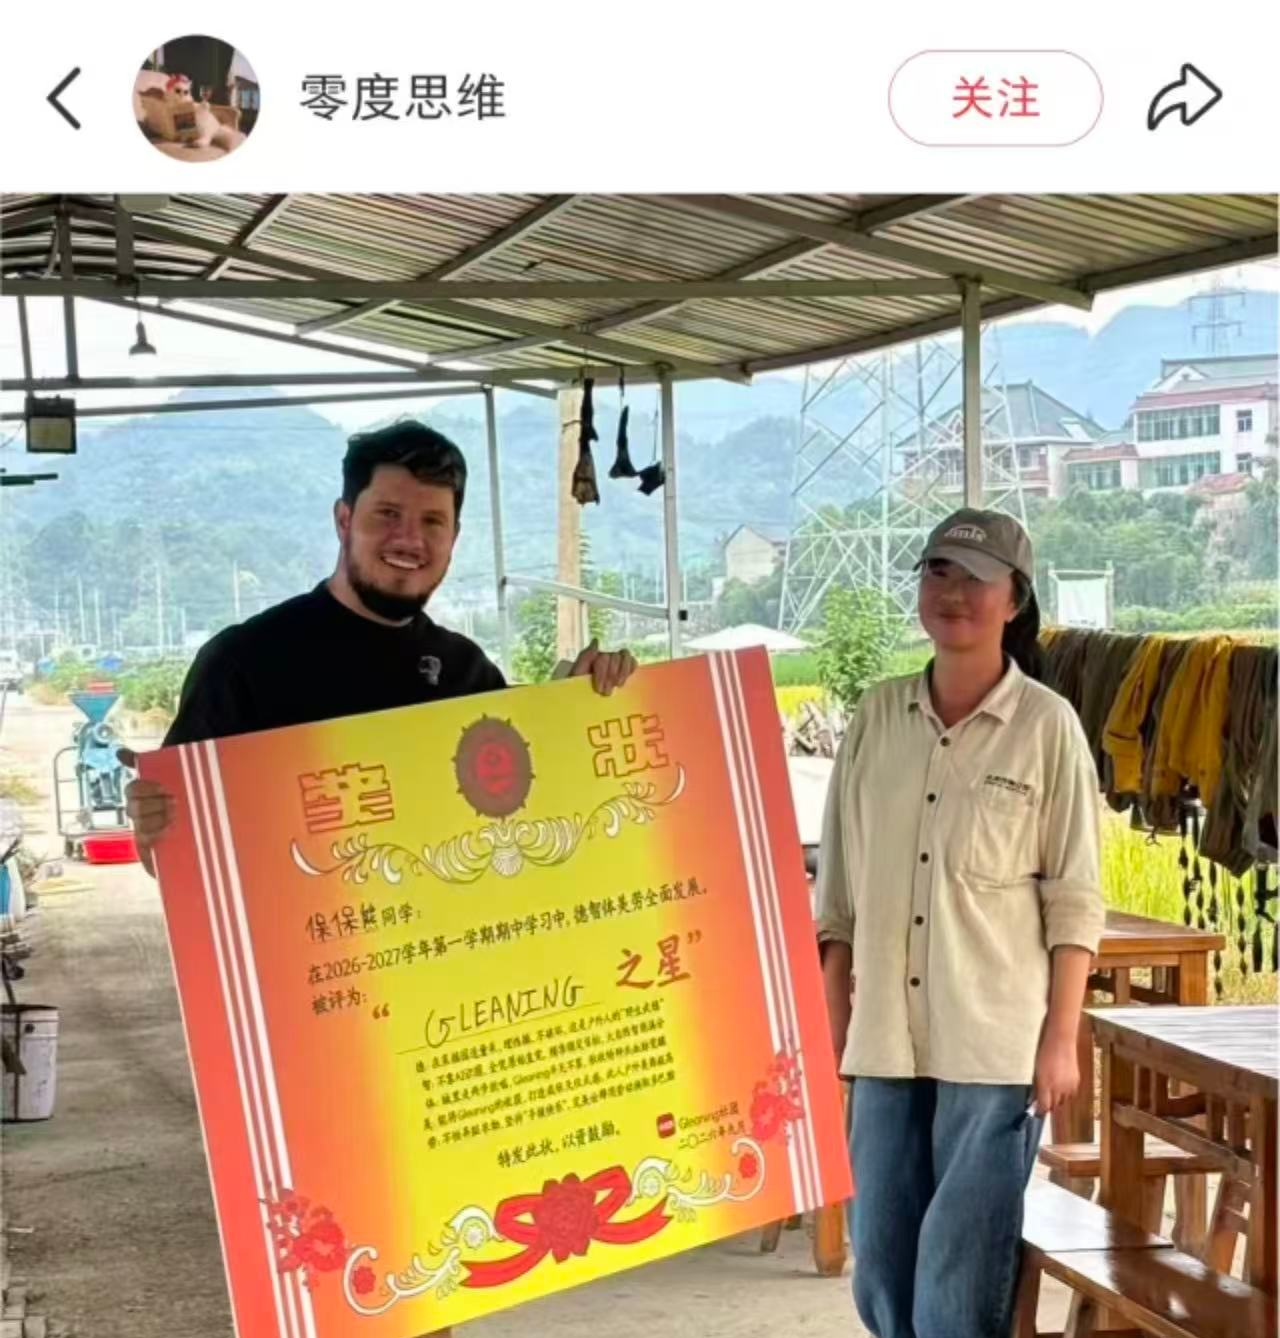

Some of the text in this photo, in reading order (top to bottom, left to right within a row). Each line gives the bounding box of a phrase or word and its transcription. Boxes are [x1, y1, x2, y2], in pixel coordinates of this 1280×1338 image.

[297, 713, 670, 834] 奖 状
[424, 974, 585, 1048] GLEANING
